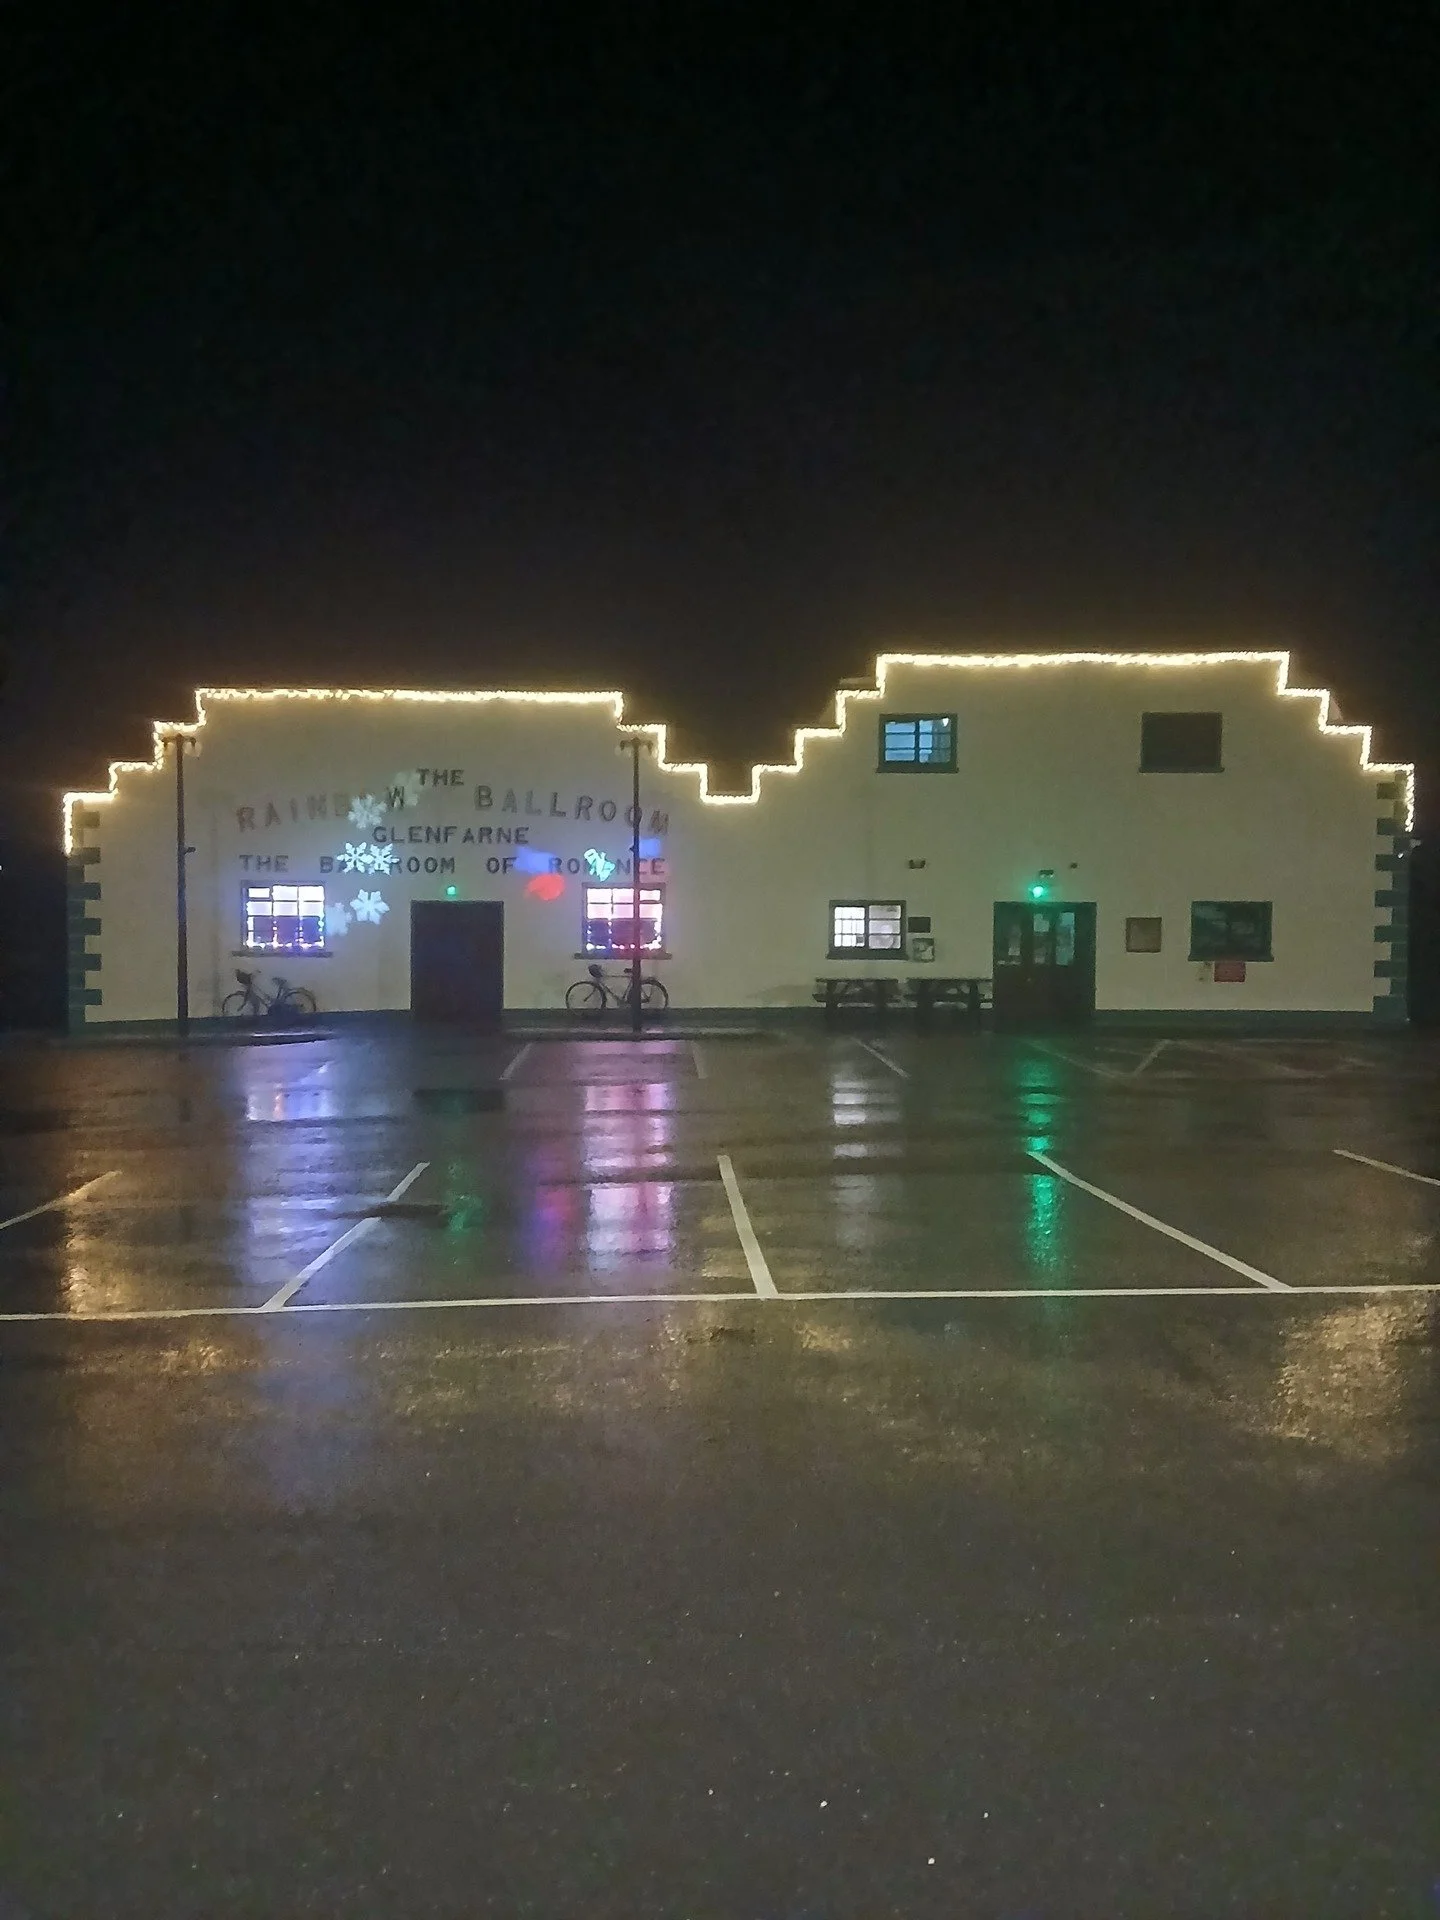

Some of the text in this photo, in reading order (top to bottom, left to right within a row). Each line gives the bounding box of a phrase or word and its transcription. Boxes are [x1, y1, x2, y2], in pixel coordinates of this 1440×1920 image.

[416, 768, 465, 787] THE
[236, 785, 670, 835] RAINBW BALLROOM
[372, 825, 530, 845] GLENFARNE
[239, 855, 289, 873] THE
[486, 856, 518, 874] OF
